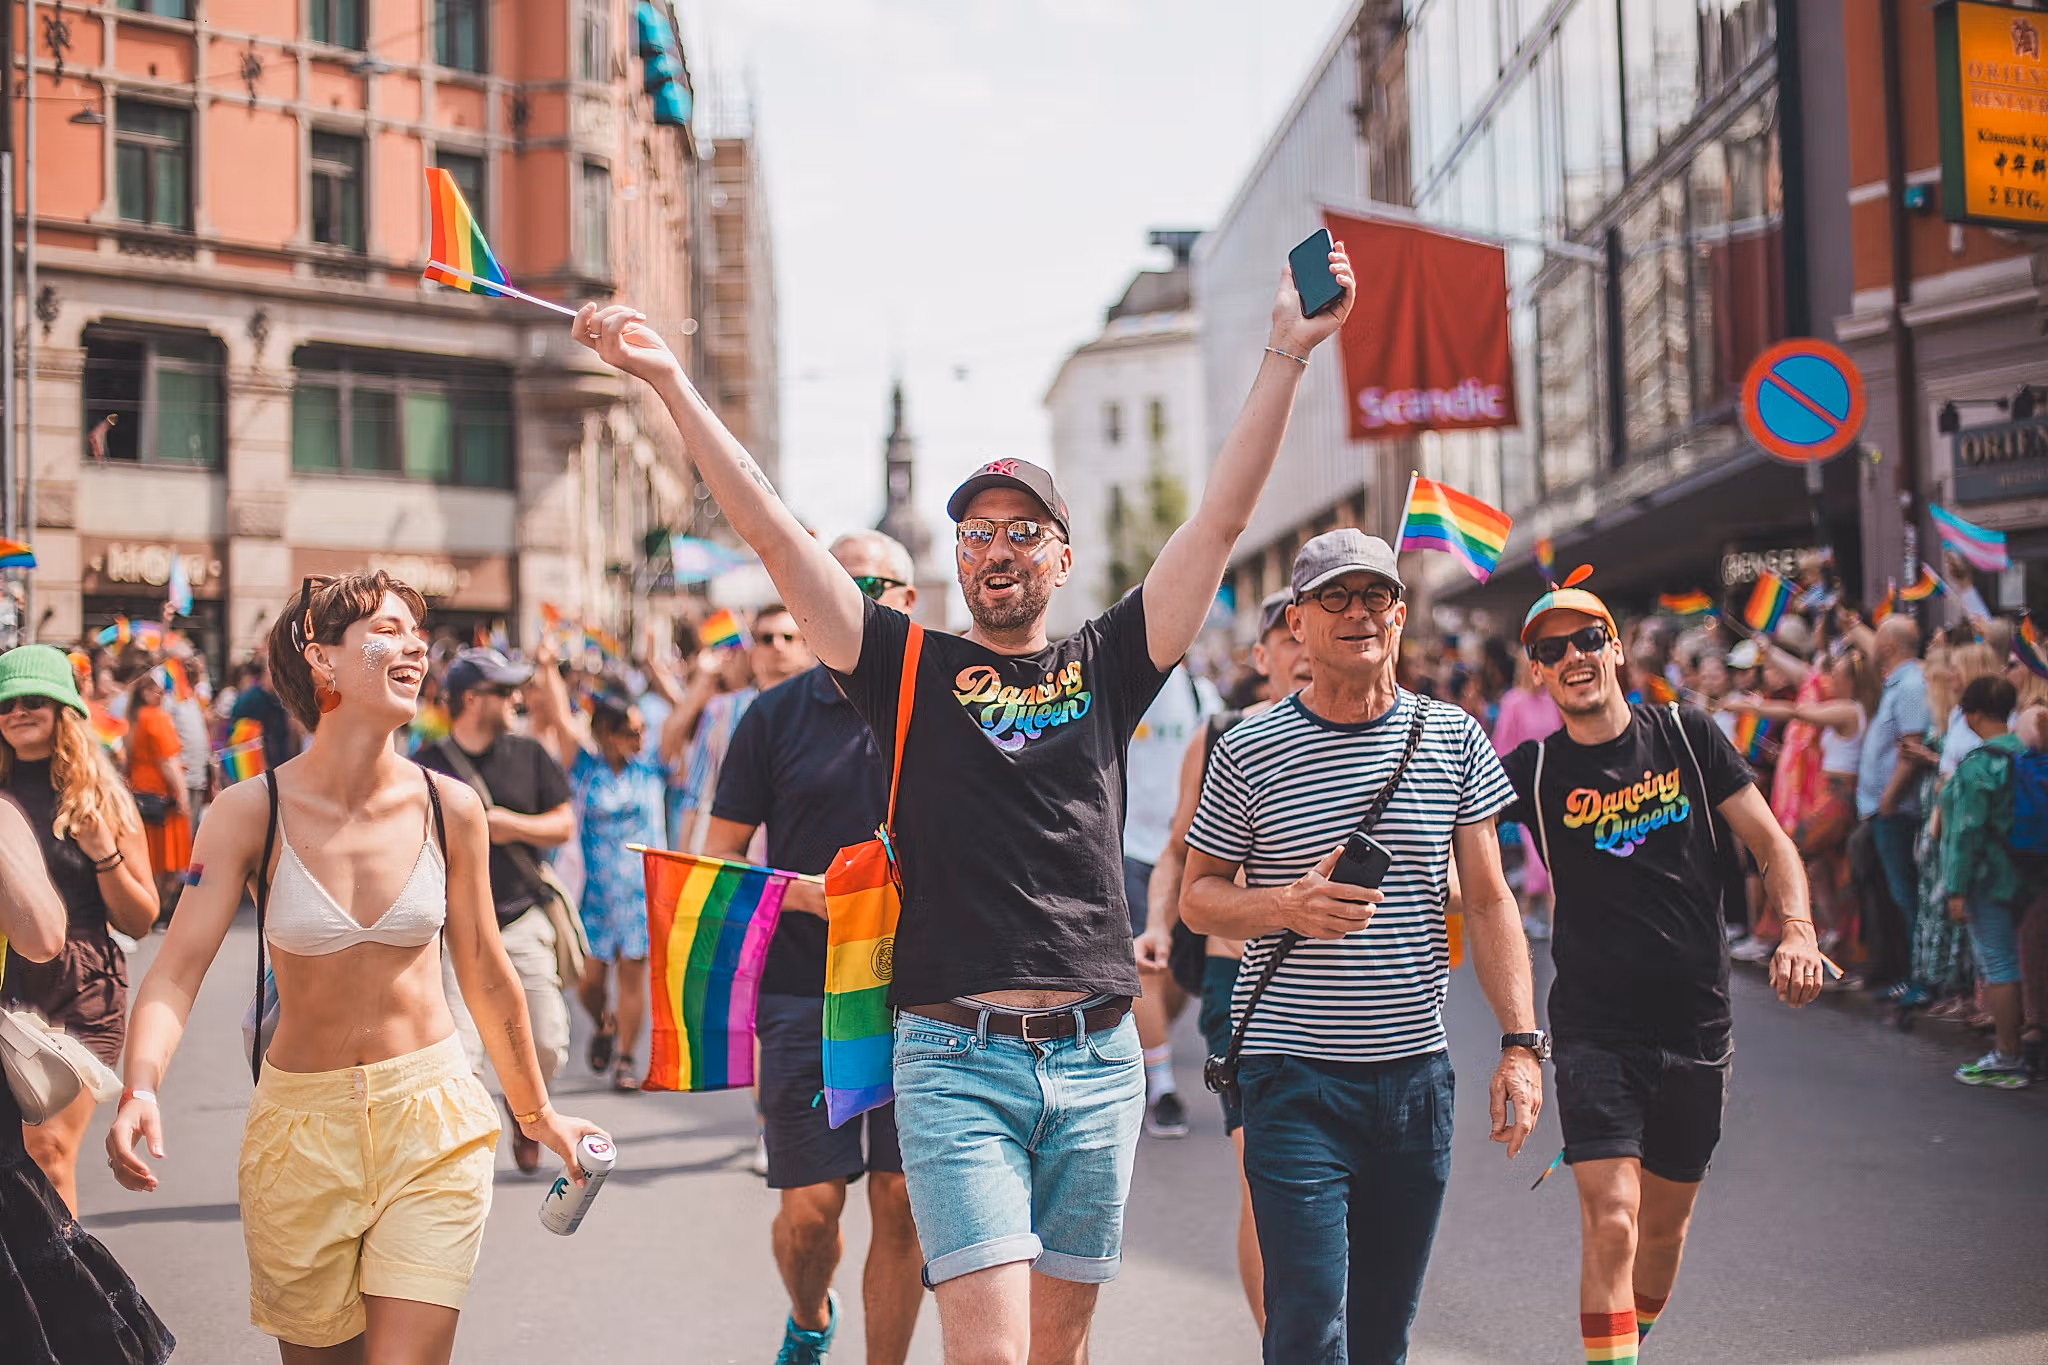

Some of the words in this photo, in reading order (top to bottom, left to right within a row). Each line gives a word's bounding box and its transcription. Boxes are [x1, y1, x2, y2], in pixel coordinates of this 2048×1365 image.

[1357, 376, 1505, 428] Scandic
[952, 660, 1083, 706] Dancing
[979, 691, 1092, 752] Queen
[1563, 767, 1680, 829] Dancing
[1594, 794, 1690, 857] Queen
